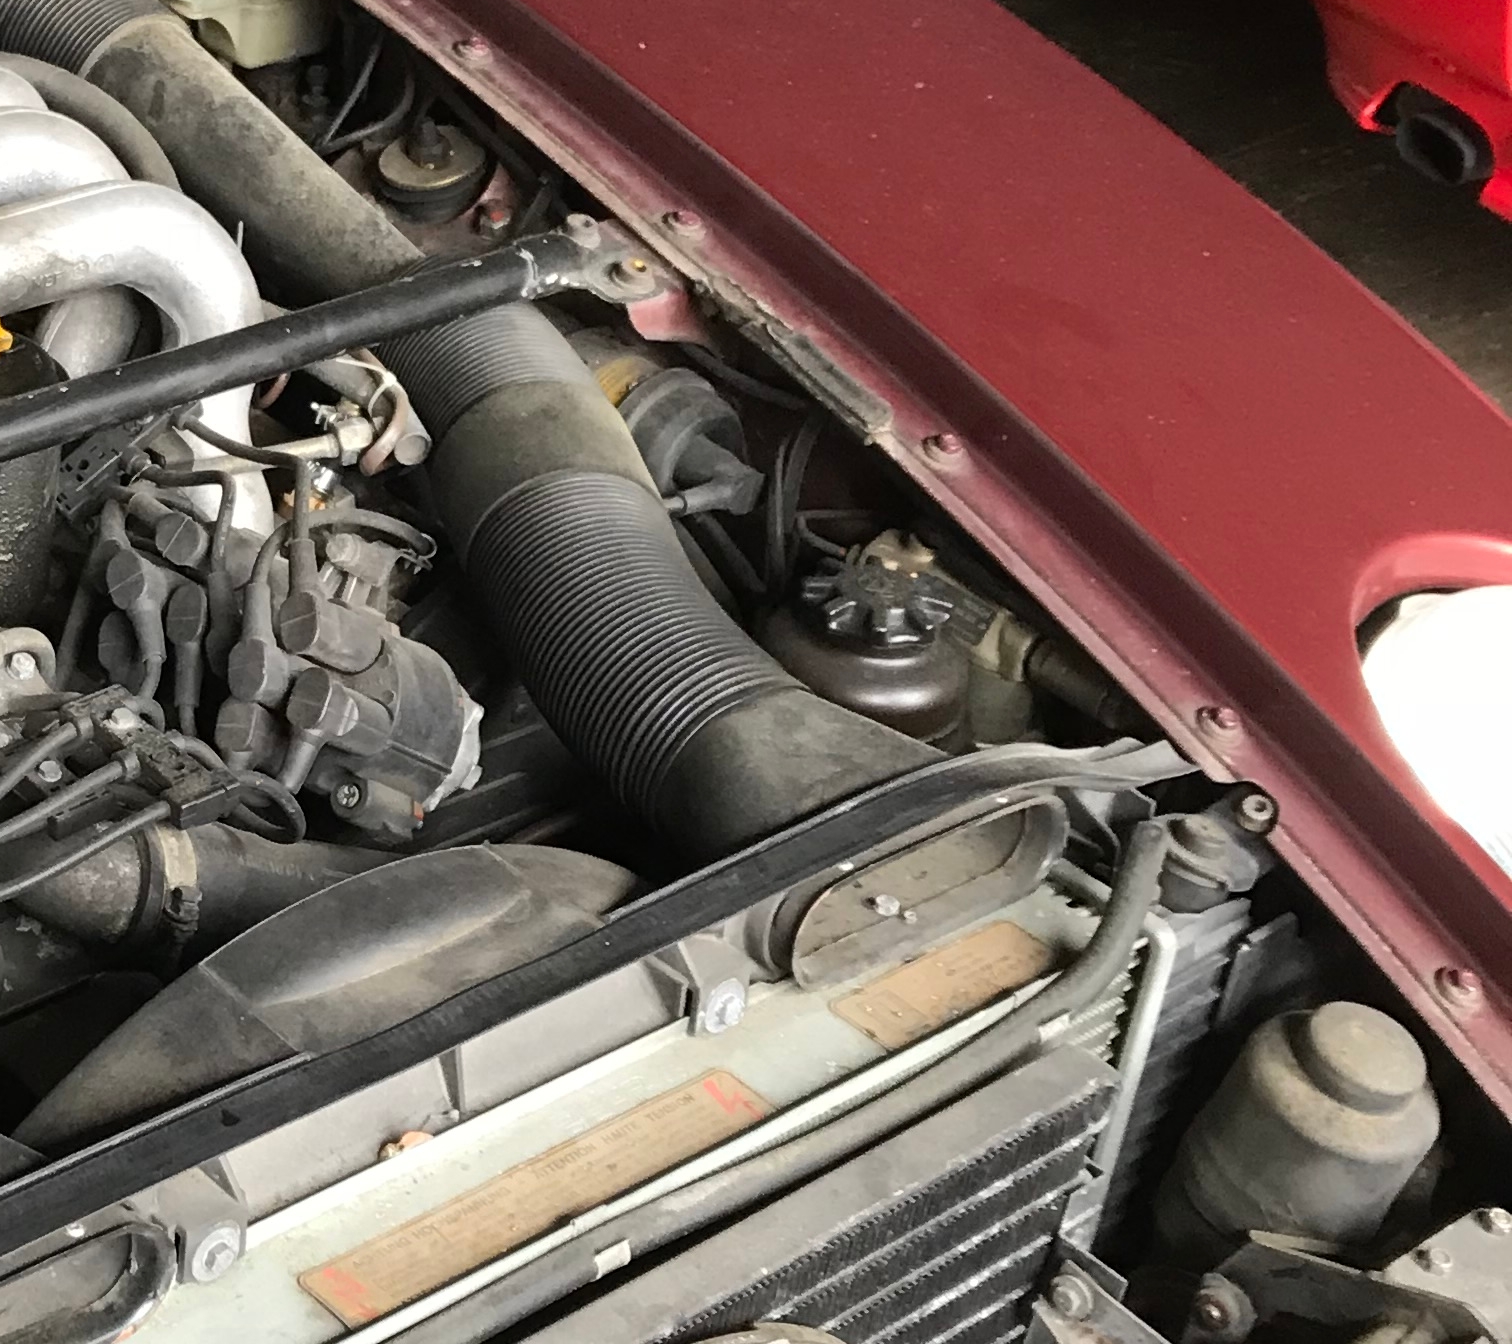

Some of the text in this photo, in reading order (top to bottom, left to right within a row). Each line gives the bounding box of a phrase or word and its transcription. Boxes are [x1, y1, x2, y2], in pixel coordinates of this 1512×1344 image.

[534, 1142, 597, 1180] ATTENTION
[601, 1120, 638, 1145] HAUTE
[646, 1092, 696, 1123] TENSION
